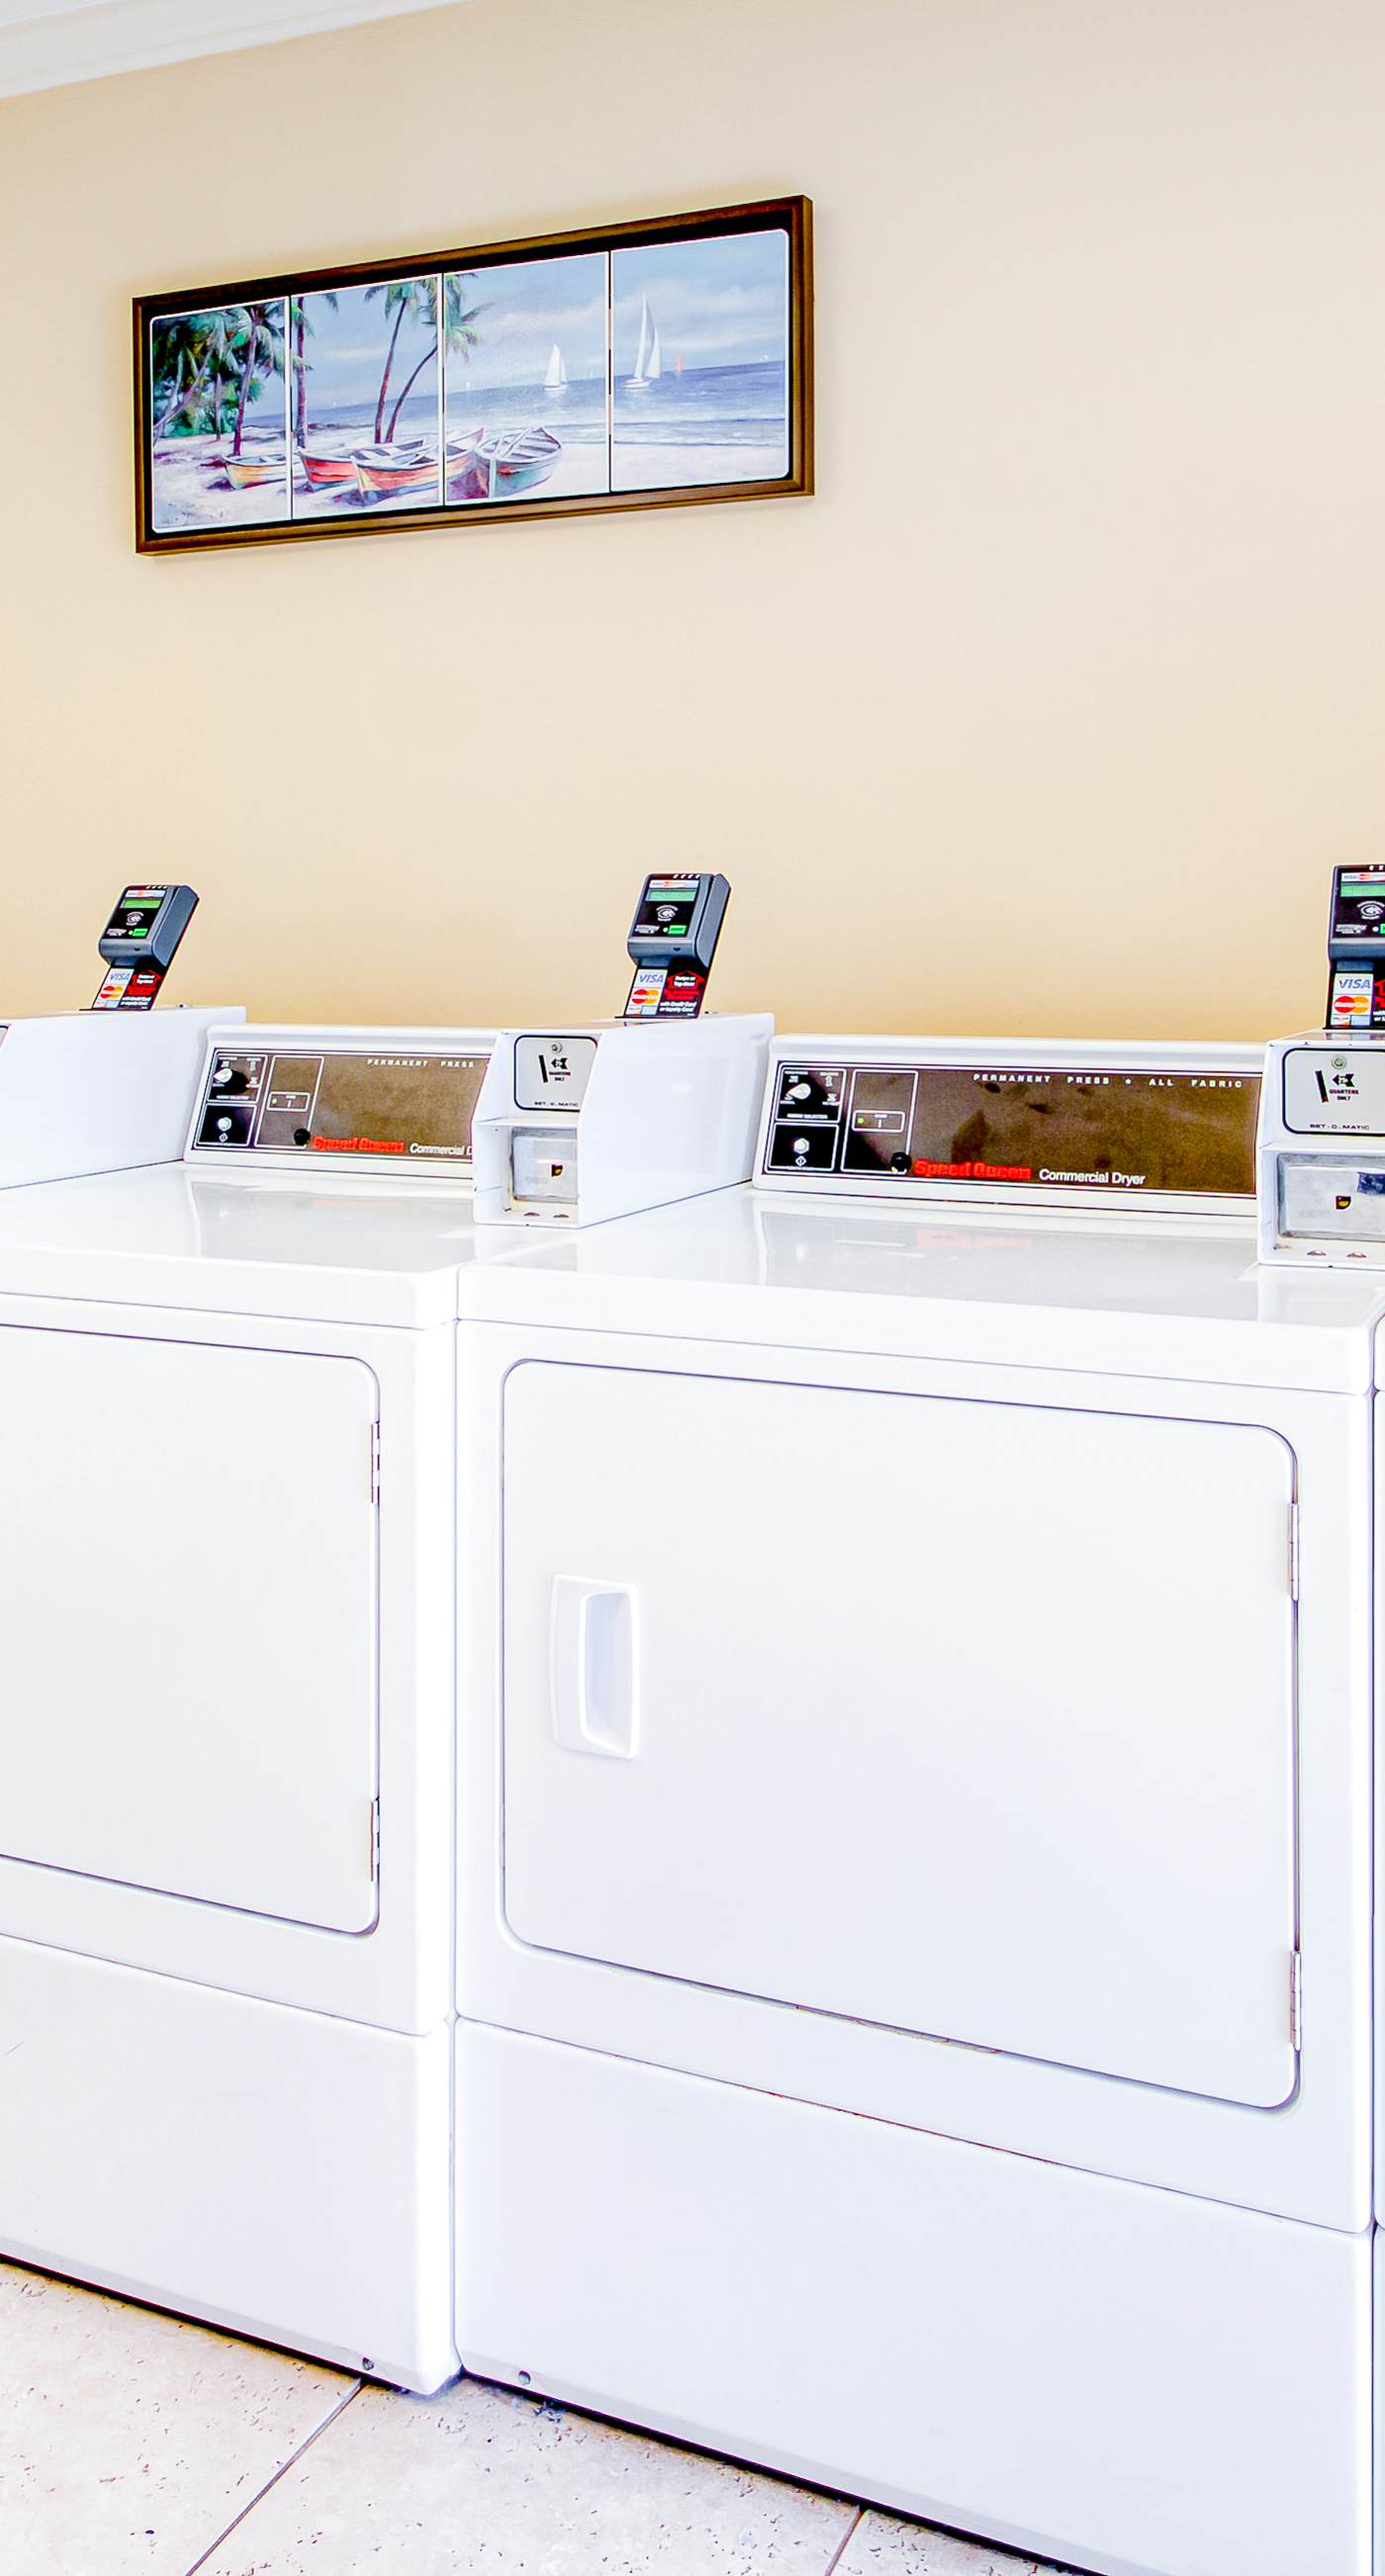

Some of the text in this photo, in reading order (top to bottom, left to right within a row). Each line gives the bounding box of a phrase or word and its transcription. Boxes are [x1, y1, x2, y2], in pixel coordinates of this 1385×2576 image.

[639, 974, 664, 983] VISA
[1339, 978, 1370, 988] VISA
[367, 1058, 428, 1067] PERMANENT
[973, 1073, 1244, 1089] PERMANENT PRESS ALL FABRIC
[313, 1136, 358, 1151] Speed
[358, 1138, 405, 1152] Queen
[410, 1143, 465, 1155] Commercial
[914, 1159, 1146, 1187] Speed Queen Commercial Dryer
